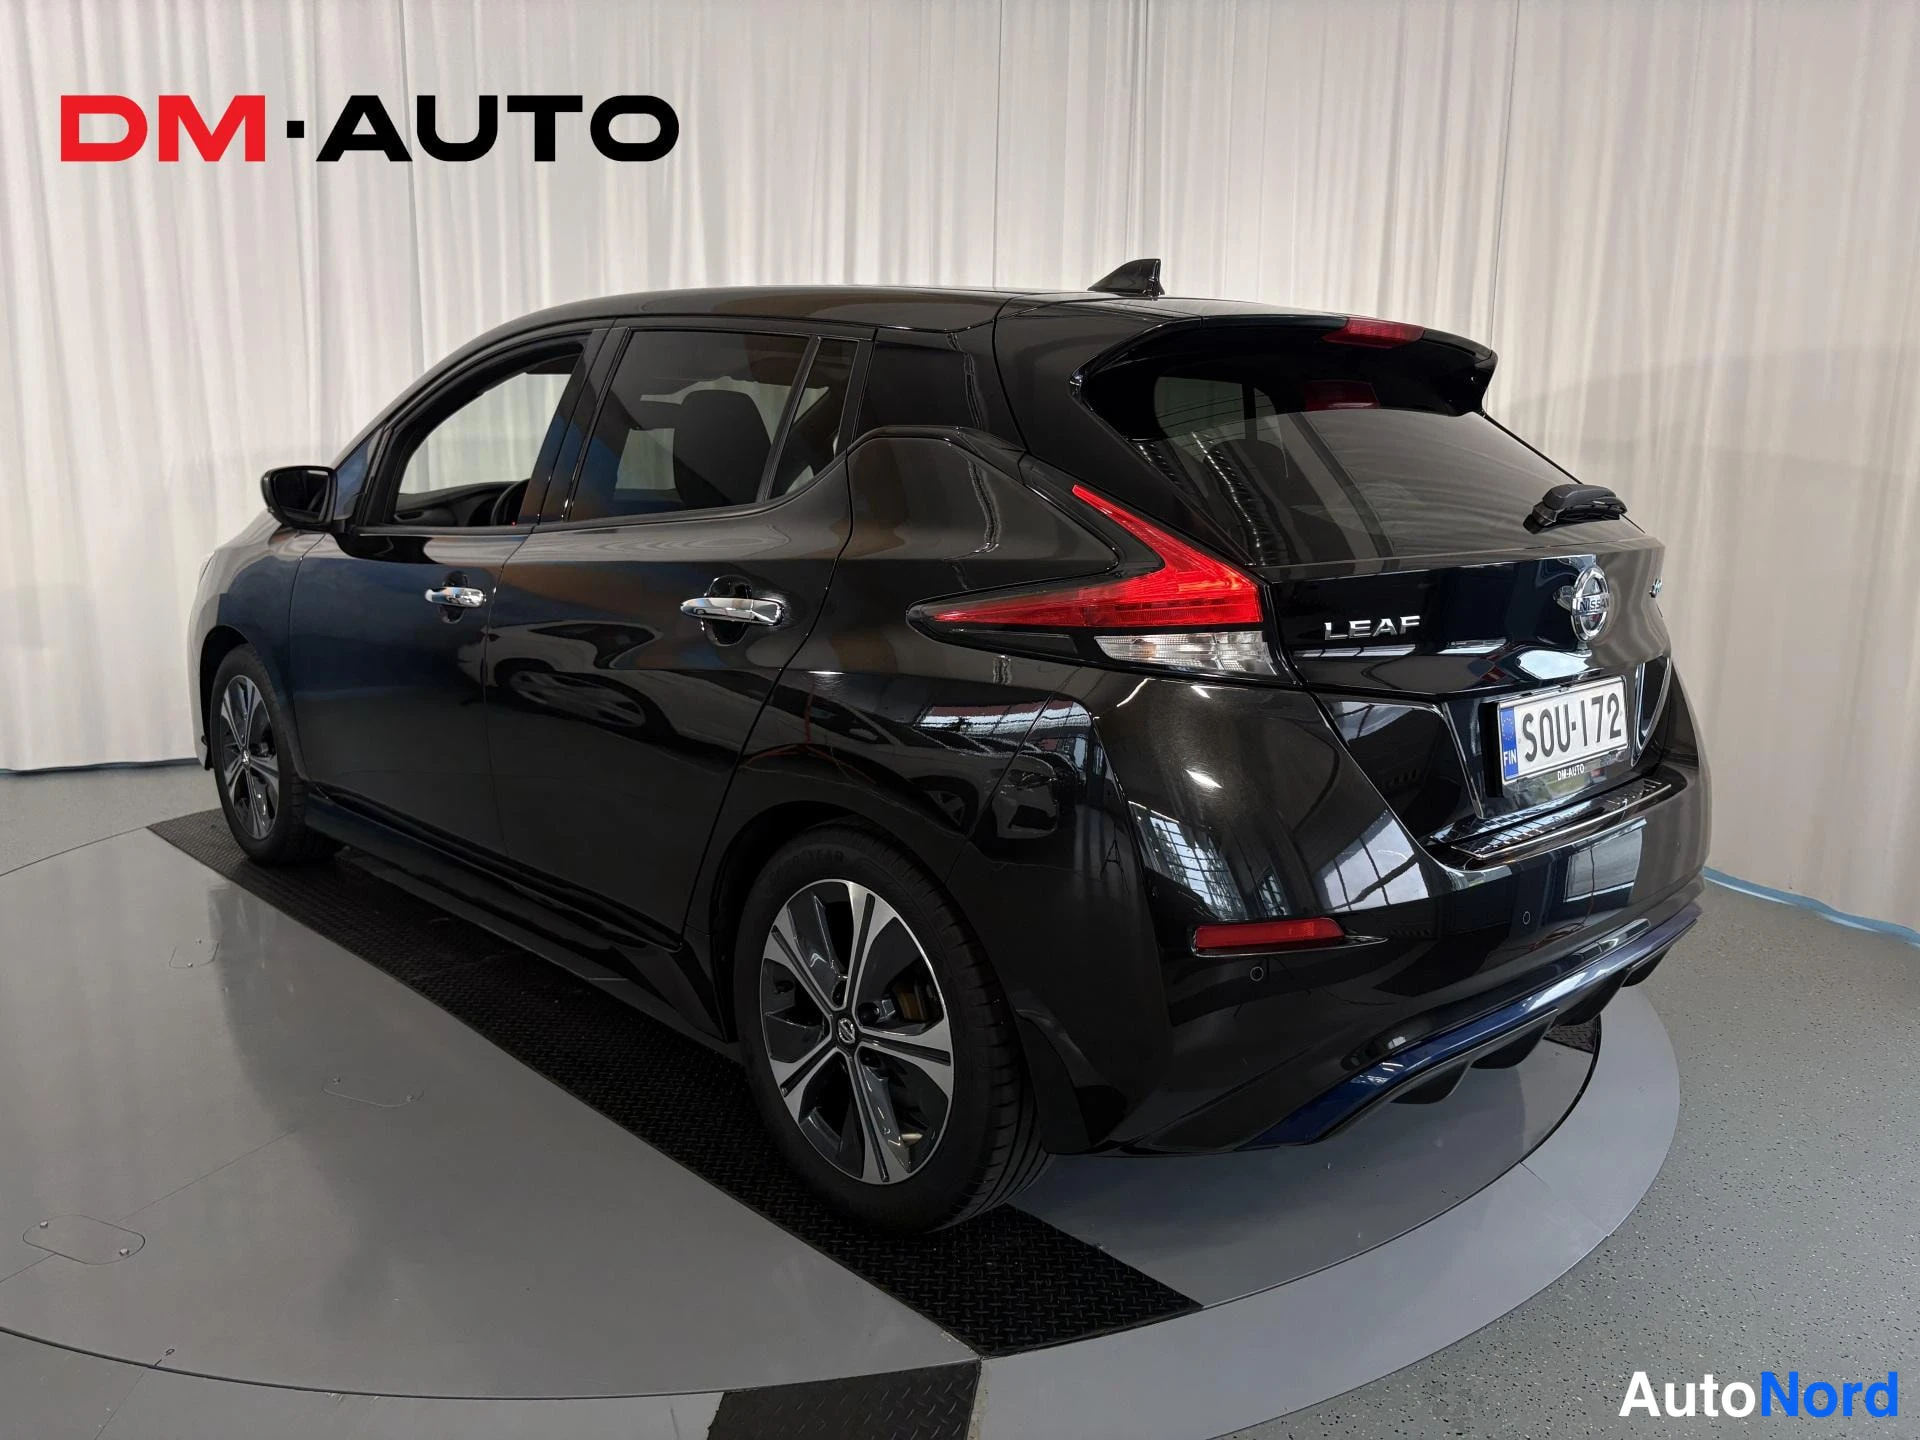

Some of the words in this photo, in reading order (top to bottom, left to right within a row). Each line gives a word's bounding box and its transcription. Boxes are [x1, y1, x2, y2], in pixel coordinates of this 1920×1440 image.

[1324, 615, 1421, 641] LEAF
[1522, 692, 1622, 762] SOU-172
[1503, 748, 1518, 767] FIN
[1557, 763, 1585, 781] DM-AUTO
